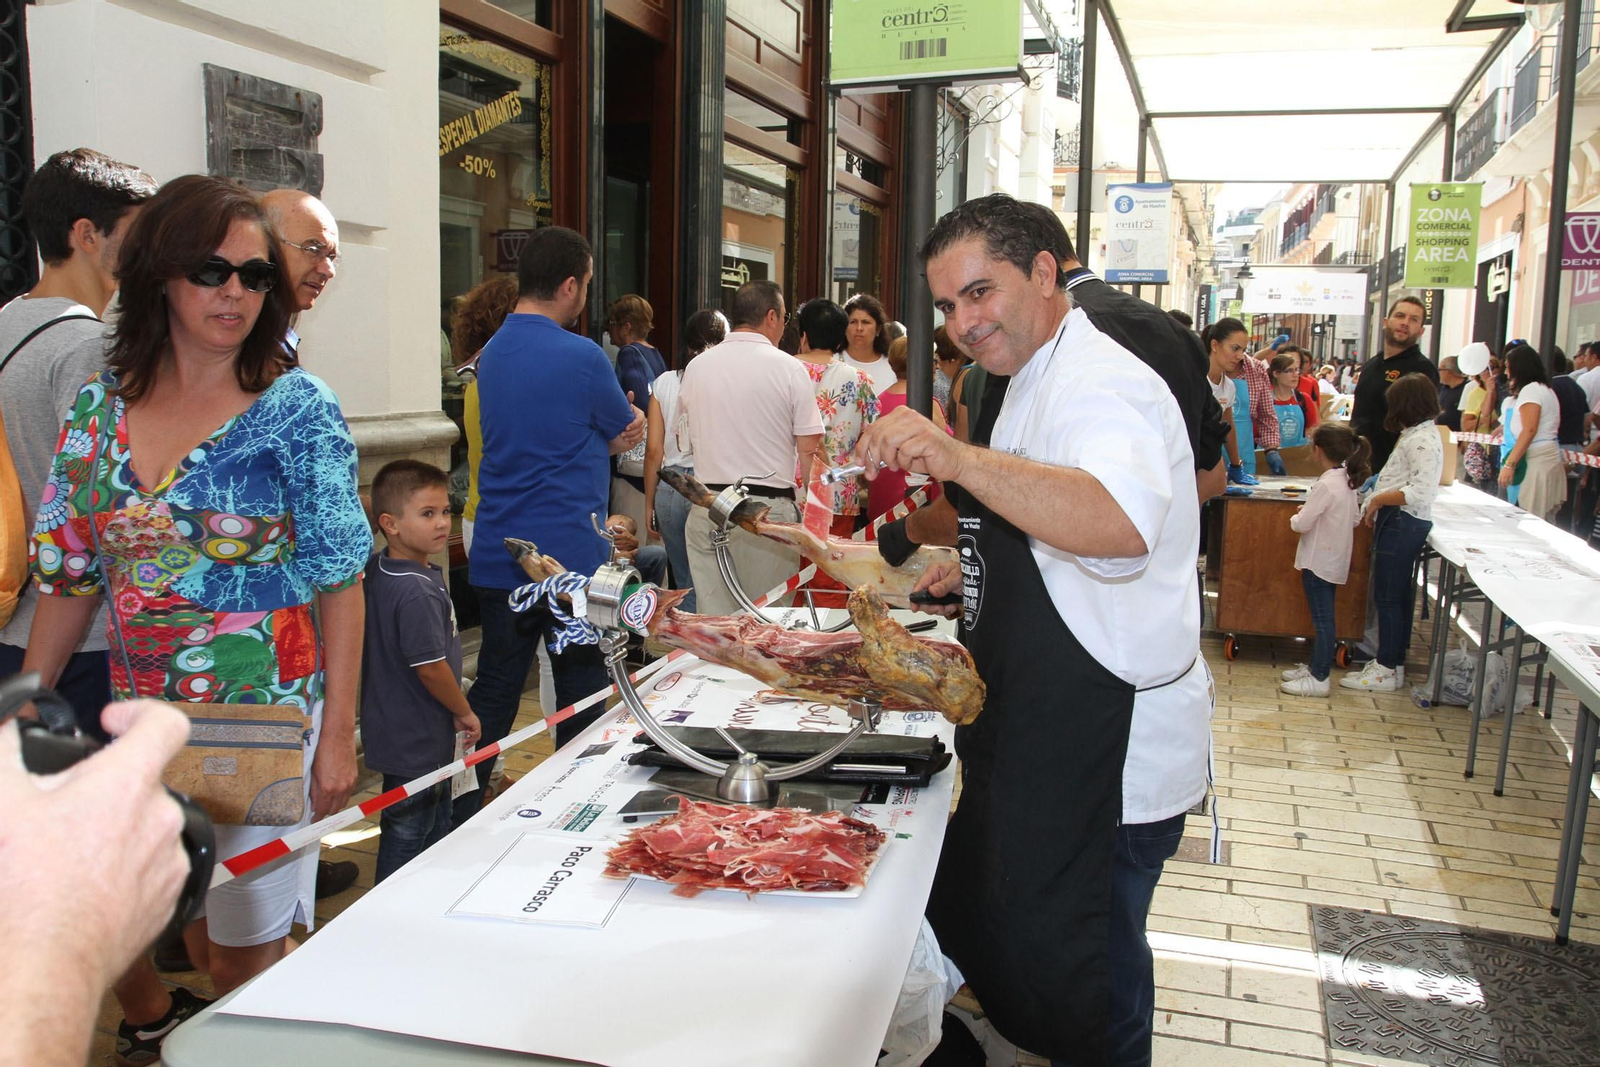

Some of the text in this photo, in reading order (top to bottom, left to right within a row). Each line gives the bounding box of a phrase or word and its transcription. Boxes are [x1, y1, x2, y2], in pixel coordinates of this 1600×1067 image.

[439, 91, 522, 156] ESPECIAL DIAMANTES
[460, 155, 496, 178] -50%
[1417, 207, 1472, 222] ZONA
[1416, 223, 1471, 231] COMERCIAL
[1416, 238, 1469, 246] SHOPPING
[1413, 247, 1469, 262] AREA
[561, 846, 593, 868] Paco
[522, 870, 573, 913] Carrasco
